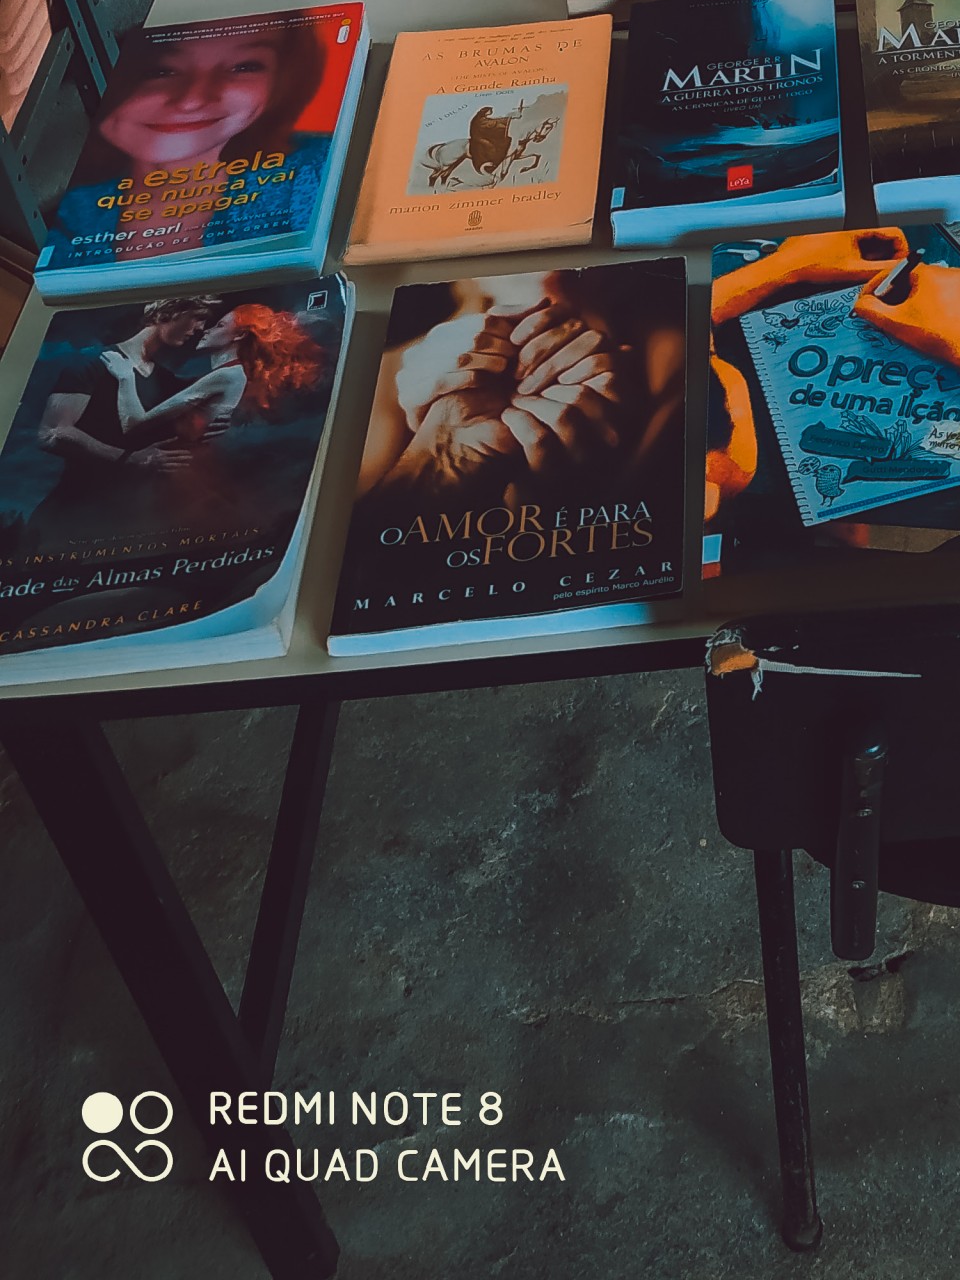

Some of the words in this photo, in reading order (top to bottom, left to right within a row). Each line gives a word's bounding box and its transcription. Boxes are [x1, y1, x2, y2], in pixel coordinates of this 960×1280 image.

[422, 51, 444, 62] AS
[458, 43, 543, 59] BRUMAS
[557, 38, 584, 52] DE
[475, 56, 530, 68] AVALON
[706, 58, 759, 71] GEORGE
[764, 56, 784, 64] R.R.
[878, 56, 888, 65] A
[436, 85, 446, 94] A
[454, 81, 503, 93] Grande
[511, 76, 557, 88] Rainha
[660, 48, 823, 92] MARTIN
[661, 95, 672, 104] A
[673, 89, 732, 102] GUERRA
[735, 84, 763, 95] DOS
[767, 74, 823, 90] TRONOS
[97, 192, 151, 209] que
[161, 179, 245, 203] nunca
[257, 166, 295, 186] vai
[117, 177, 133, 191] a
[144, 151, 286, 187] estrela
[119, 207, 153, 223] se
[161, 190, 262, 219] apagar
[389, 203, 440, 215] marion
[448, 197, 504, 210] zimmer
[511, 190, 562, 205] bradley
[67, 241, 165, 259] INTRODUÇÃO
[173, 236, 189, 246] DE
[198, 228, 235, 240] JOHN
[243, 219, 290, 232] GREEN
[71, 225, 137, 246] esther
[142, 223, 183, 239] earl
[233, 212, 266, 224] WAYNE
[788, 344, 829, 378] O
[789, 383, 827, 408] de
[830, 391, 893, 417] uma
[400, 504, 546, 547] AMOR
[555, 506, 569, 529] É
[578, 500, 654, 527] PARA
[24, 541, 168, 566] INSTRUMENTOS
[179, 528, 260, 547] MORTAIS
[446, 548, 482, 568] OS
[480, 518, 655, 566] FORTES
[86, 564, 164, 588] Almas
[171, 544, 276, 576] Perdidas
[351, 581, 527, 611] MARCELO
[559, 561, 673, 588] CEZAR
[553, 589, 573, 601] pelo
[612, 581, 640, 591] Marco
[0, 615, 125, 644] CASSANDRA
[138, 599, 202, 622] CLARE
